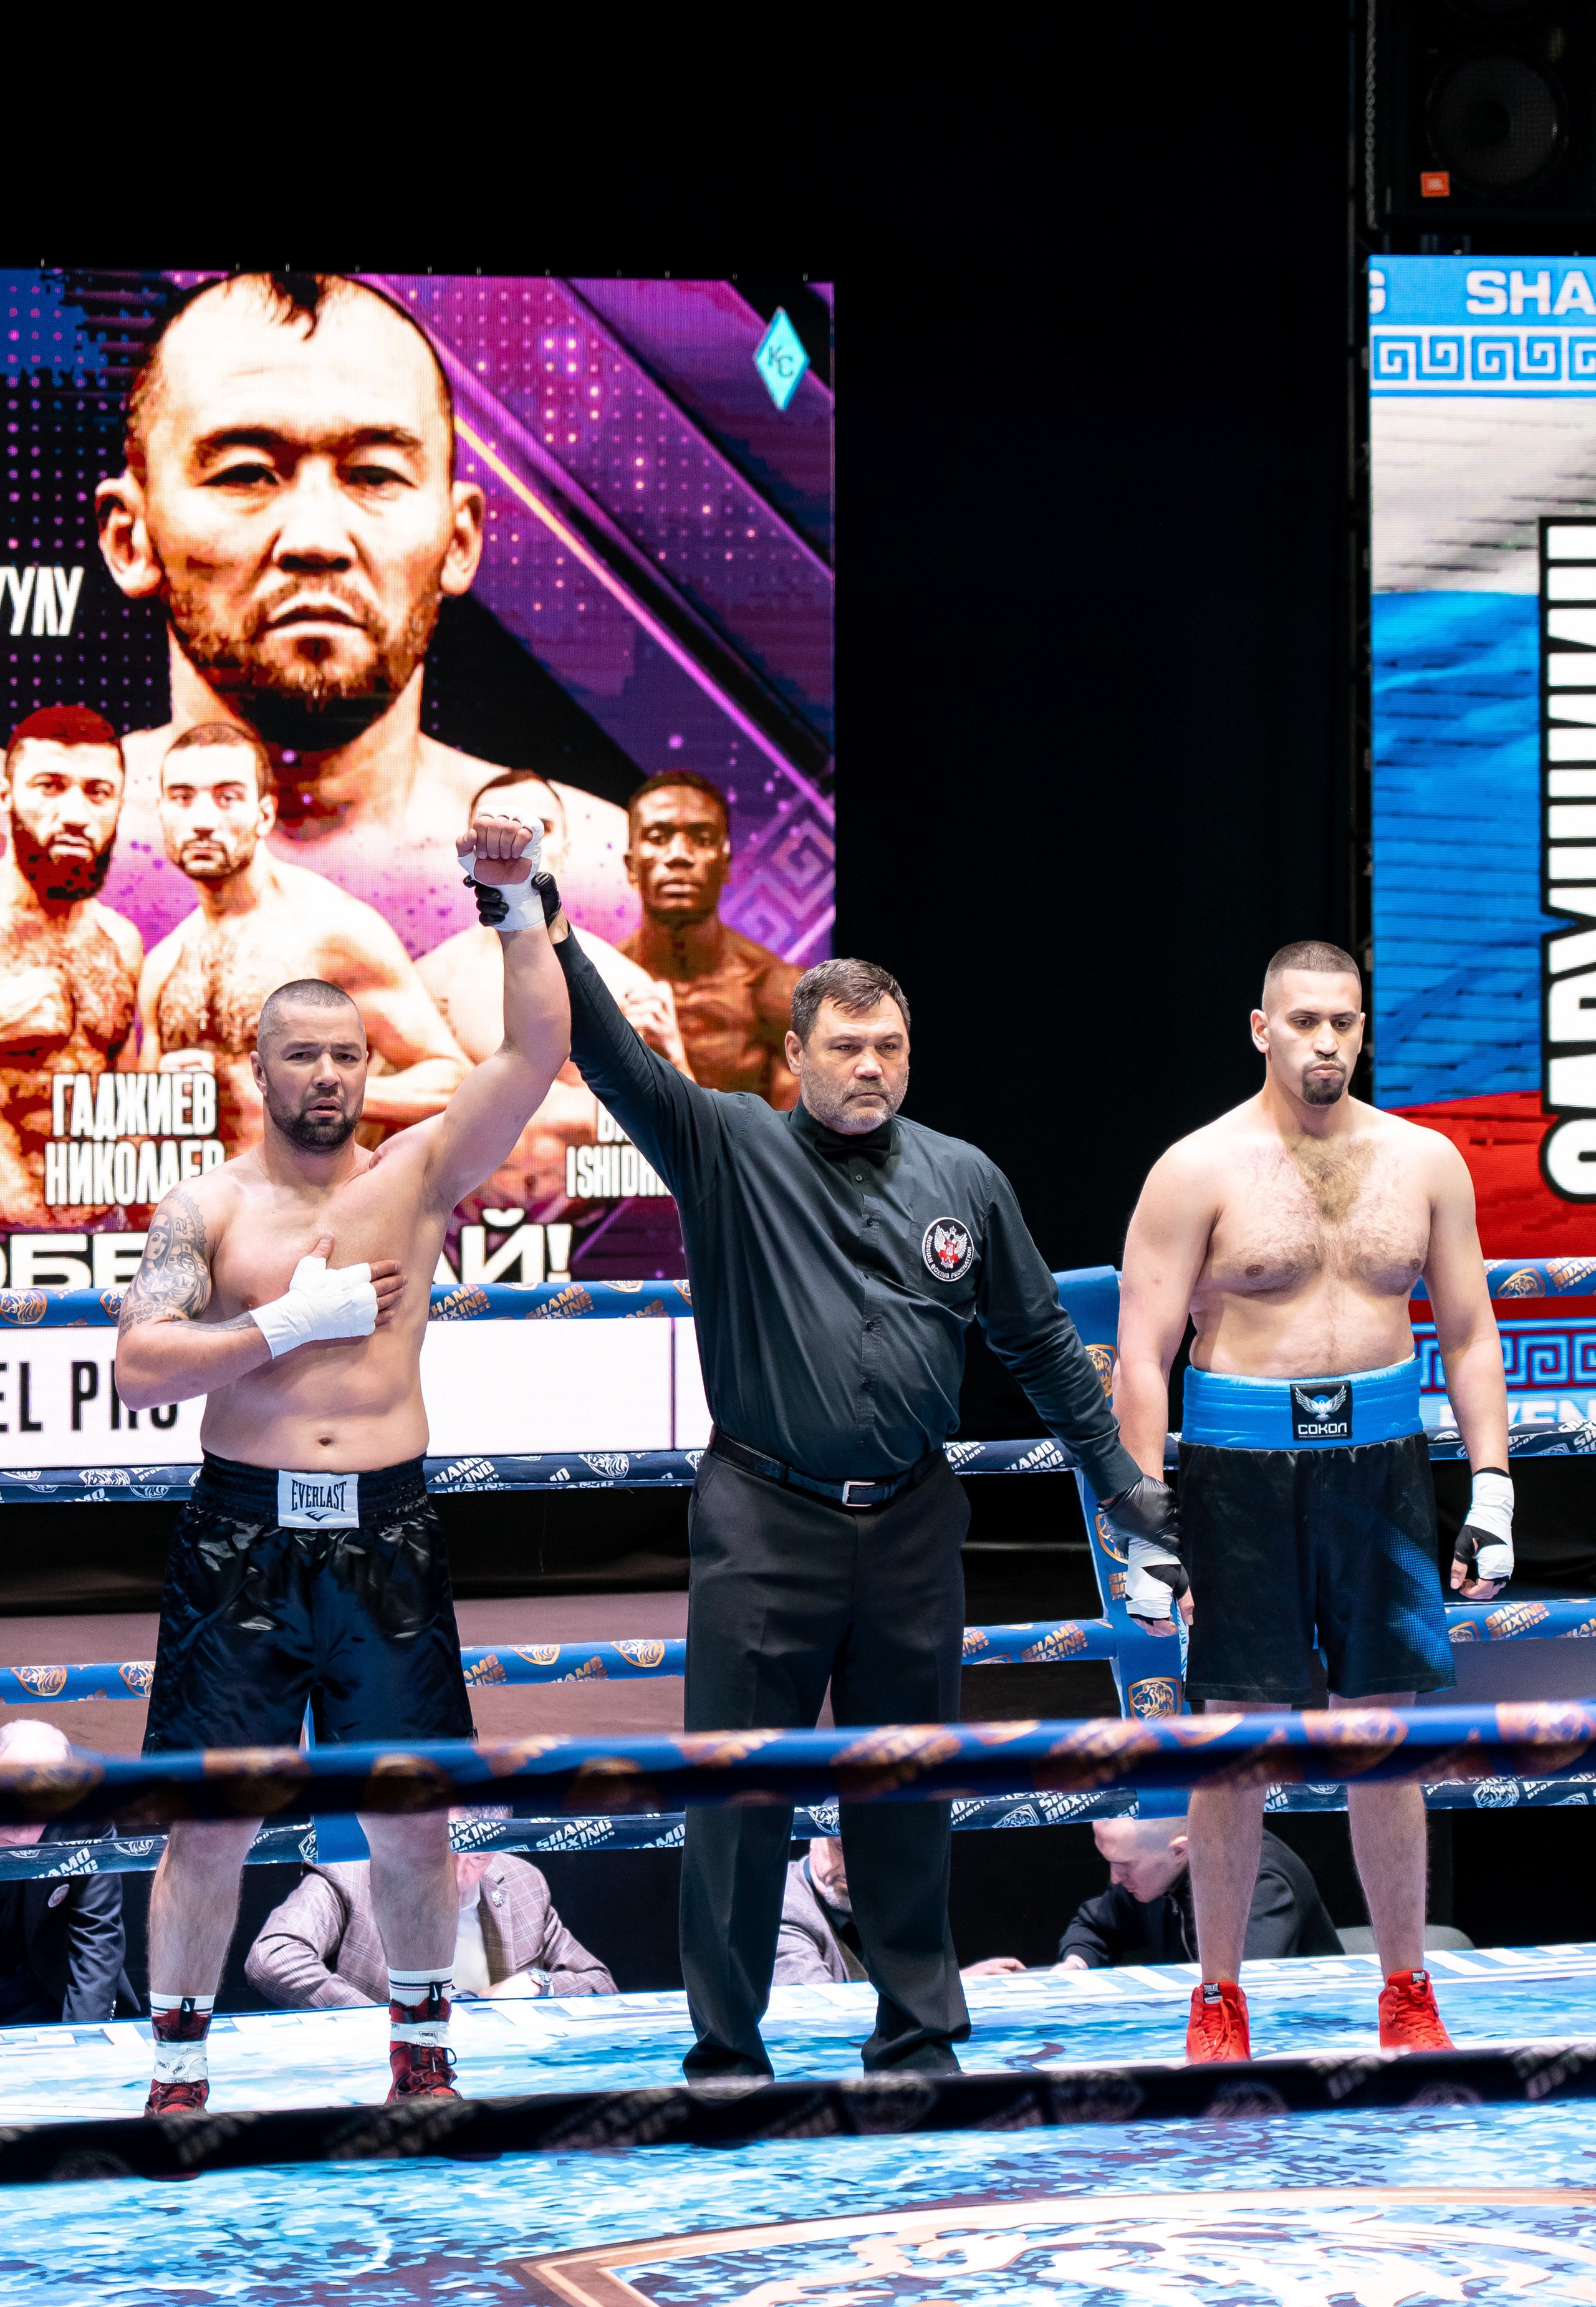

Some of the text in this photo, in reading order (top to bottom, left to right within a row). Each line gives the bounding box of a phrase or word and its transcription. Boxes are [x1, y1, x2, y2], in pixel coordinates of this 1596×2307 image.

[52, 1072, 217, 1140] ГАДЖИЕВ
[931, 1263, 949, 1279] BOXING
[951, 1247, 972, 1279] FEDERATION
[1298, 1423, 1347, 1435] СОКОЛ
[291, 1478, 347, 1513] EVERLAST
